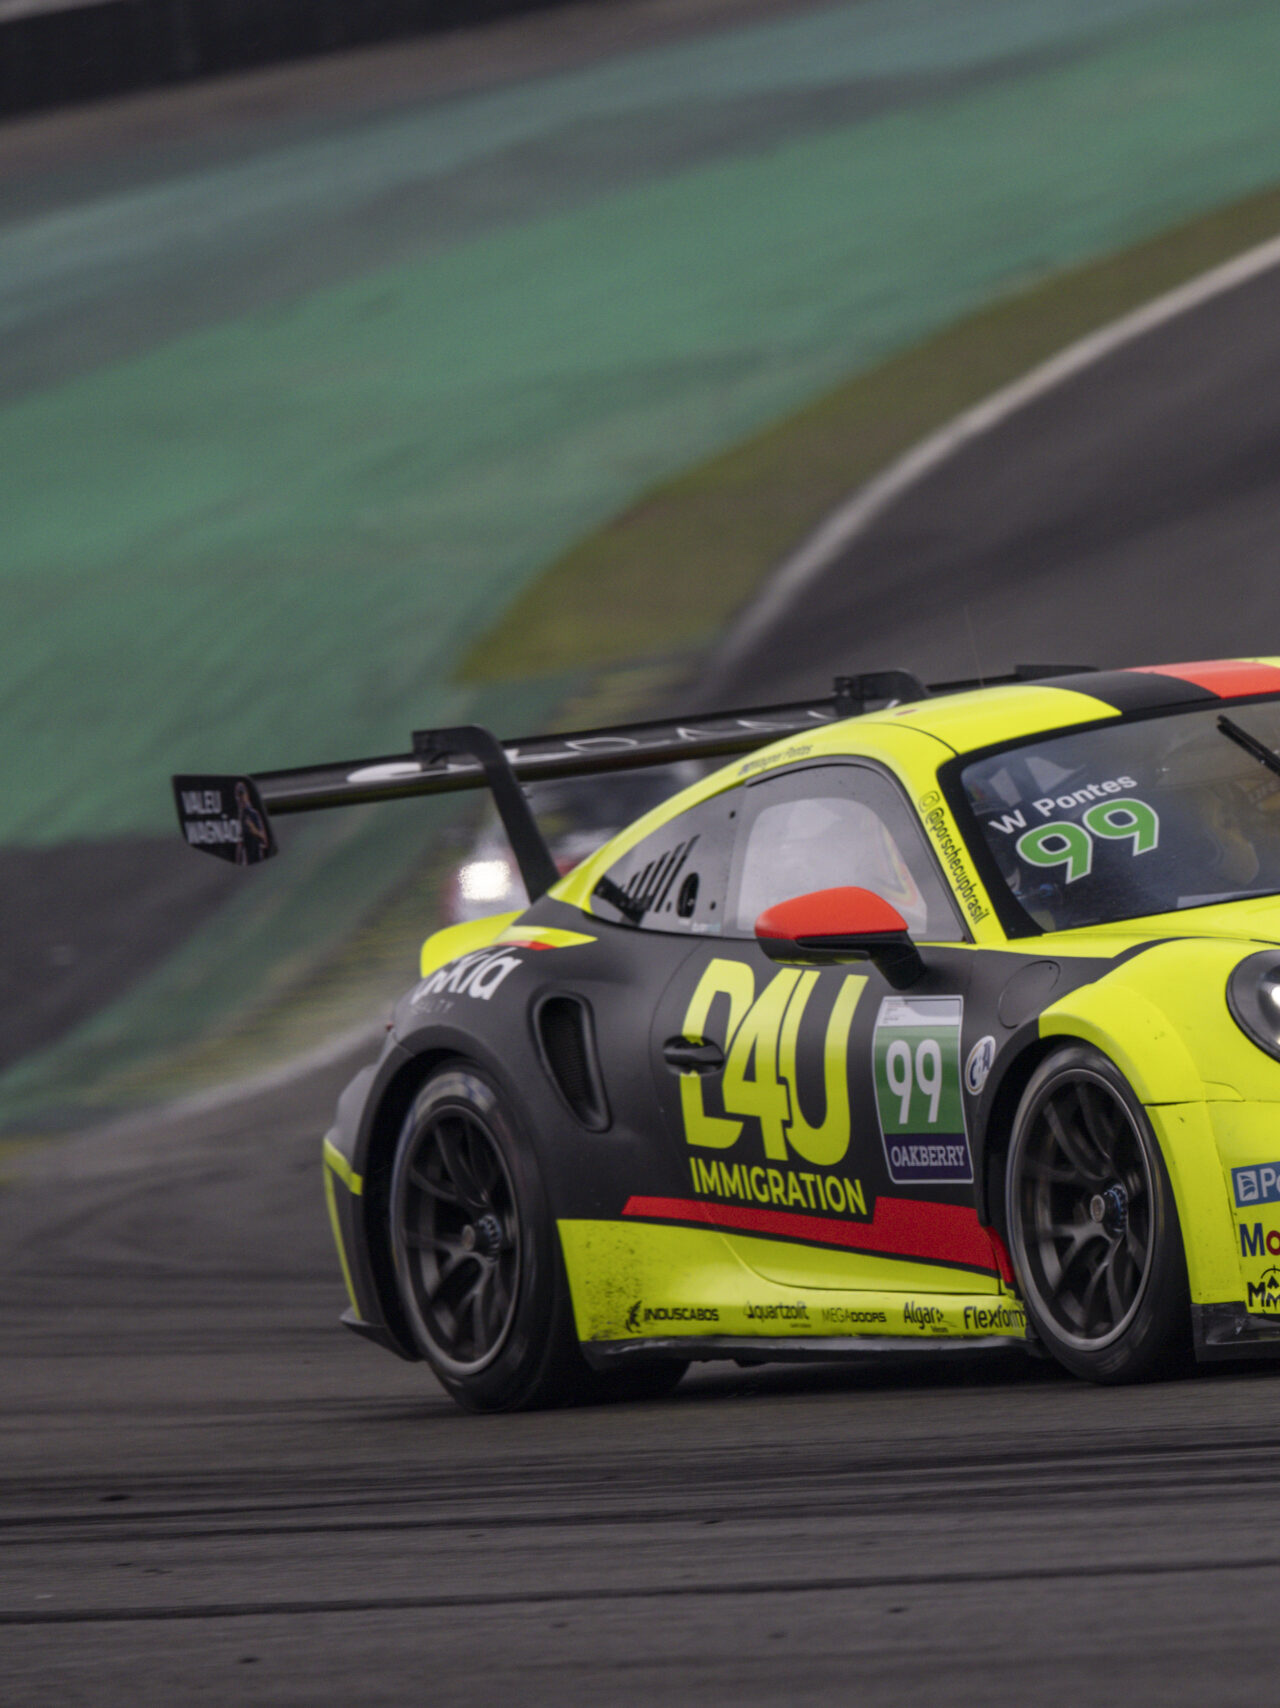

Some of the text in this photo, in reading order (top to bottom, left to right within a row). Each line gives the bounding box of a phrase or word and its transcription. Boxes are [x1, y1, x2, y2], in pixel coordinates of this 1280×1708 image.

[181, 790, 222, 814] VALEU
[989, 774, 1138, 835] W Pontes
[925, 807, 990, 924] @porschecupbrasil
[1016, 797, 1160, 884] 99
[679, 958, 869, 1166] D4U
[886, 1039, 942, 1124] 99
[890, 1144, 965, 1168] OAKBERRY
[689, 1157, 868, 1216] IMMIGRATION
[643, 1307, 720, 1322] INDUSCABOS
[903, 1300, 936, 1329] Algar
